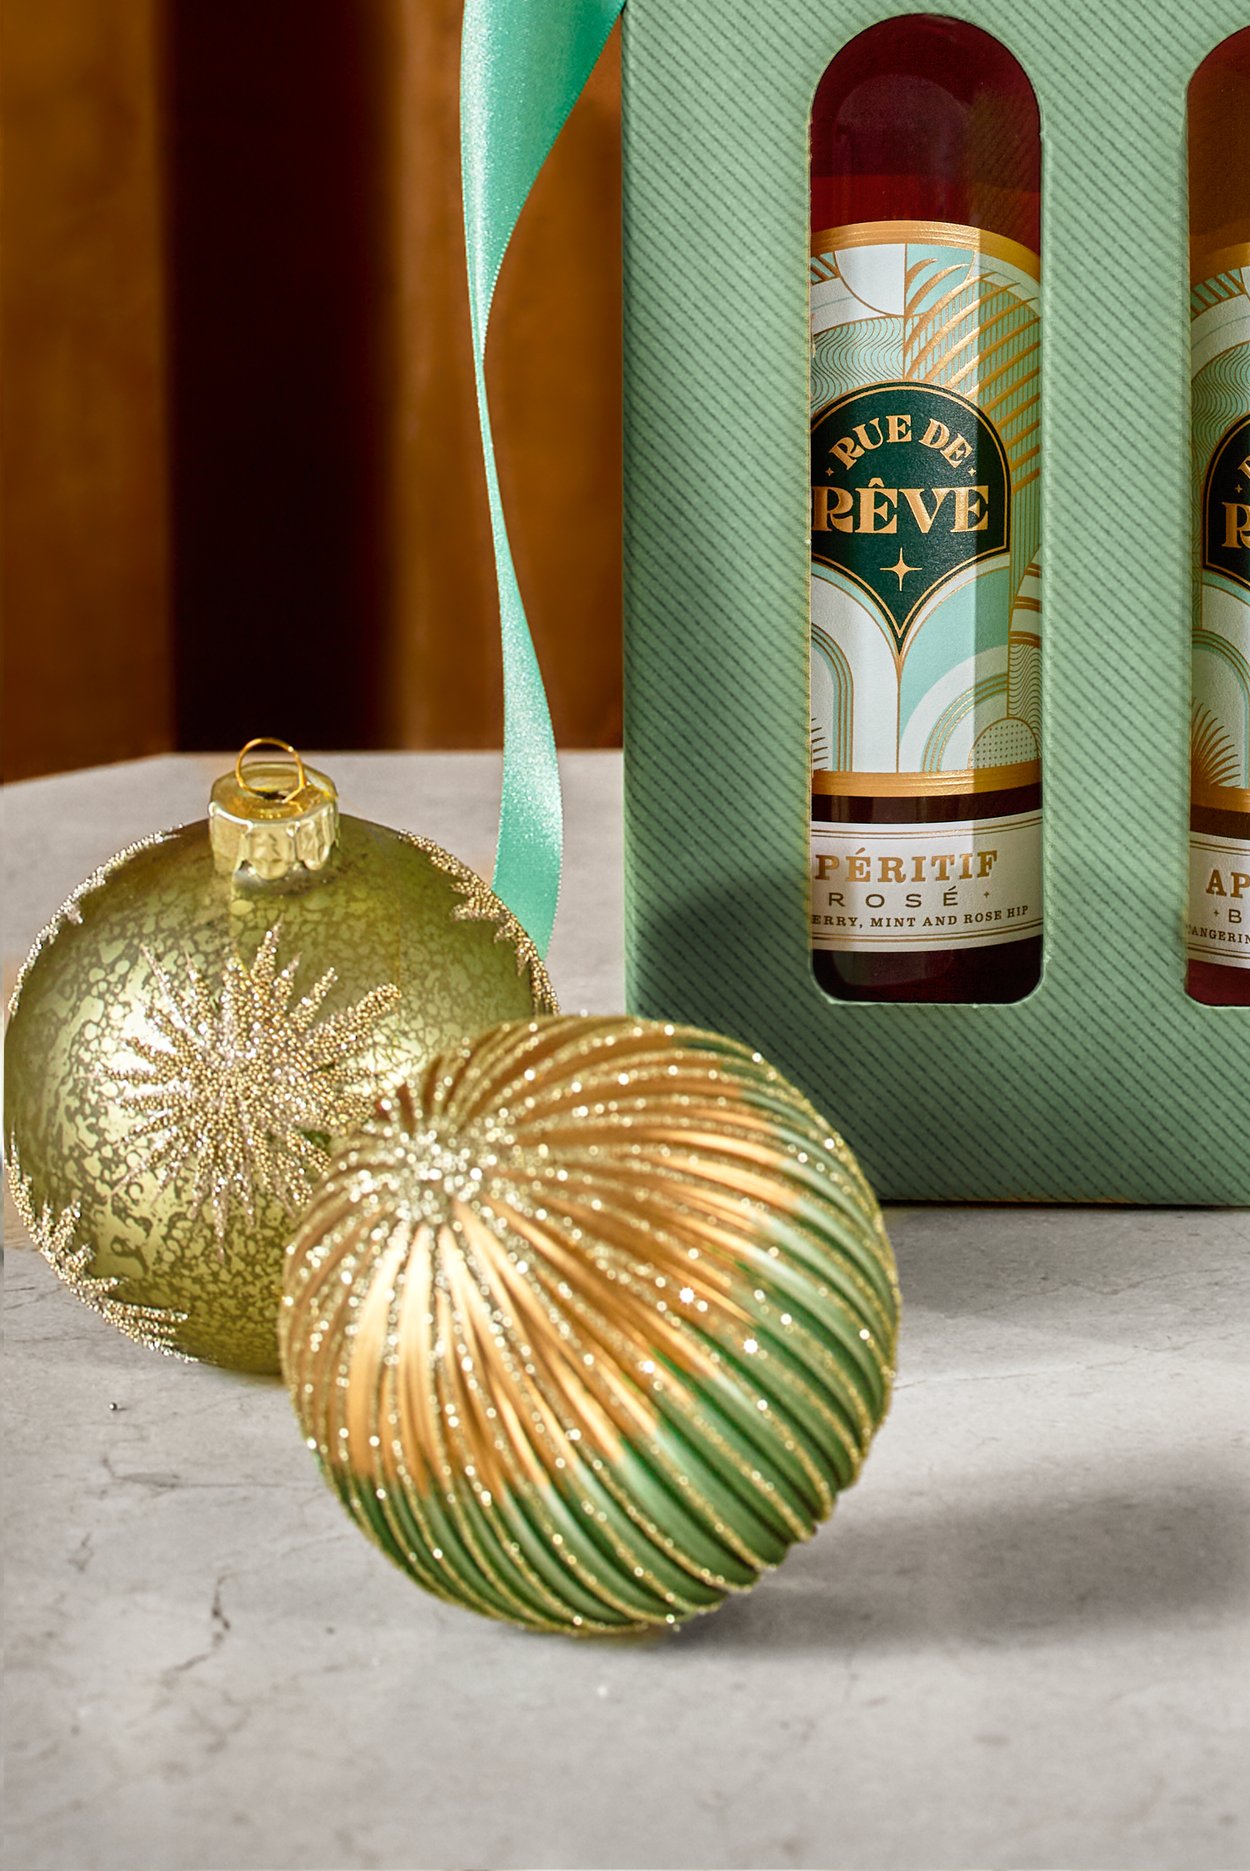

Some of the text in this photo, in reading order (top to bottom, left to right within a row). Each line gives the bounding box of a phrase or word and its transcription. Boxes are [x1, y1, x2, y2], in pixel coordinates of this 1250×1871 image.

[828, 414, 973, 470] RUE DE
[811, 477, 989, 534] RÊVE
[814, 846, 998, 883] PÉRITIF
[828, 885, 959, 908] ROSÉ
[870, 916, 916, 928] MINT
[922, 914, 958, 927] AND
[964, 909, 1002, 924] ROSE
[1006, 904, 1029, 919] HIP
